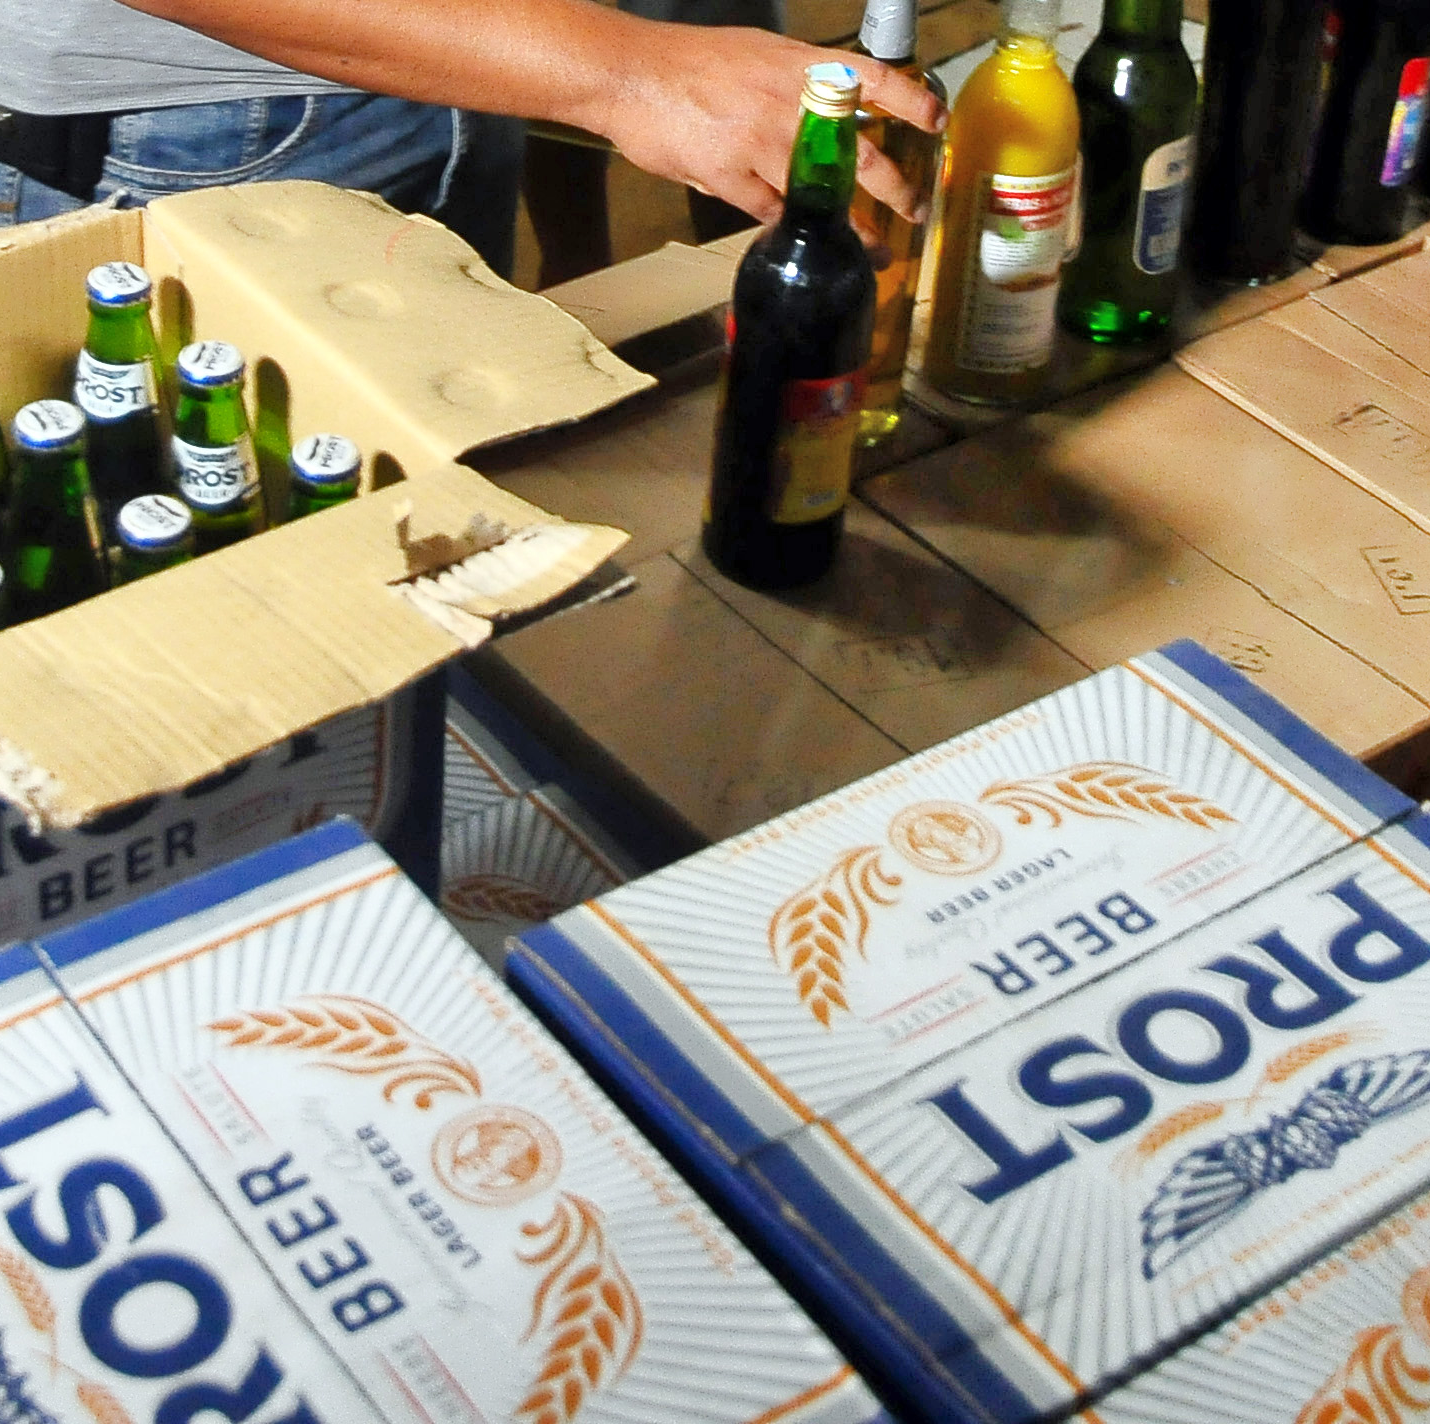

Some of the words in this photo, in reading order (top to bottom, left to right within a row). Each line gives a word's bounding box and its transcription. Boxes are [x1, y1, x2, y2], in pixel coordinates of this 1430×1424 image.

[39, 817, 197, 922] BEER
[924, 887, 992, 926] BEER
[995, 849, 1072, 895] LAGER
[970, 891, 1159, 995] BEER
[355, 1121, 415, 1188] BEER
[238, 1151, 406, 1332] BEER
[408, 1190, 483, 1269] LAGER
